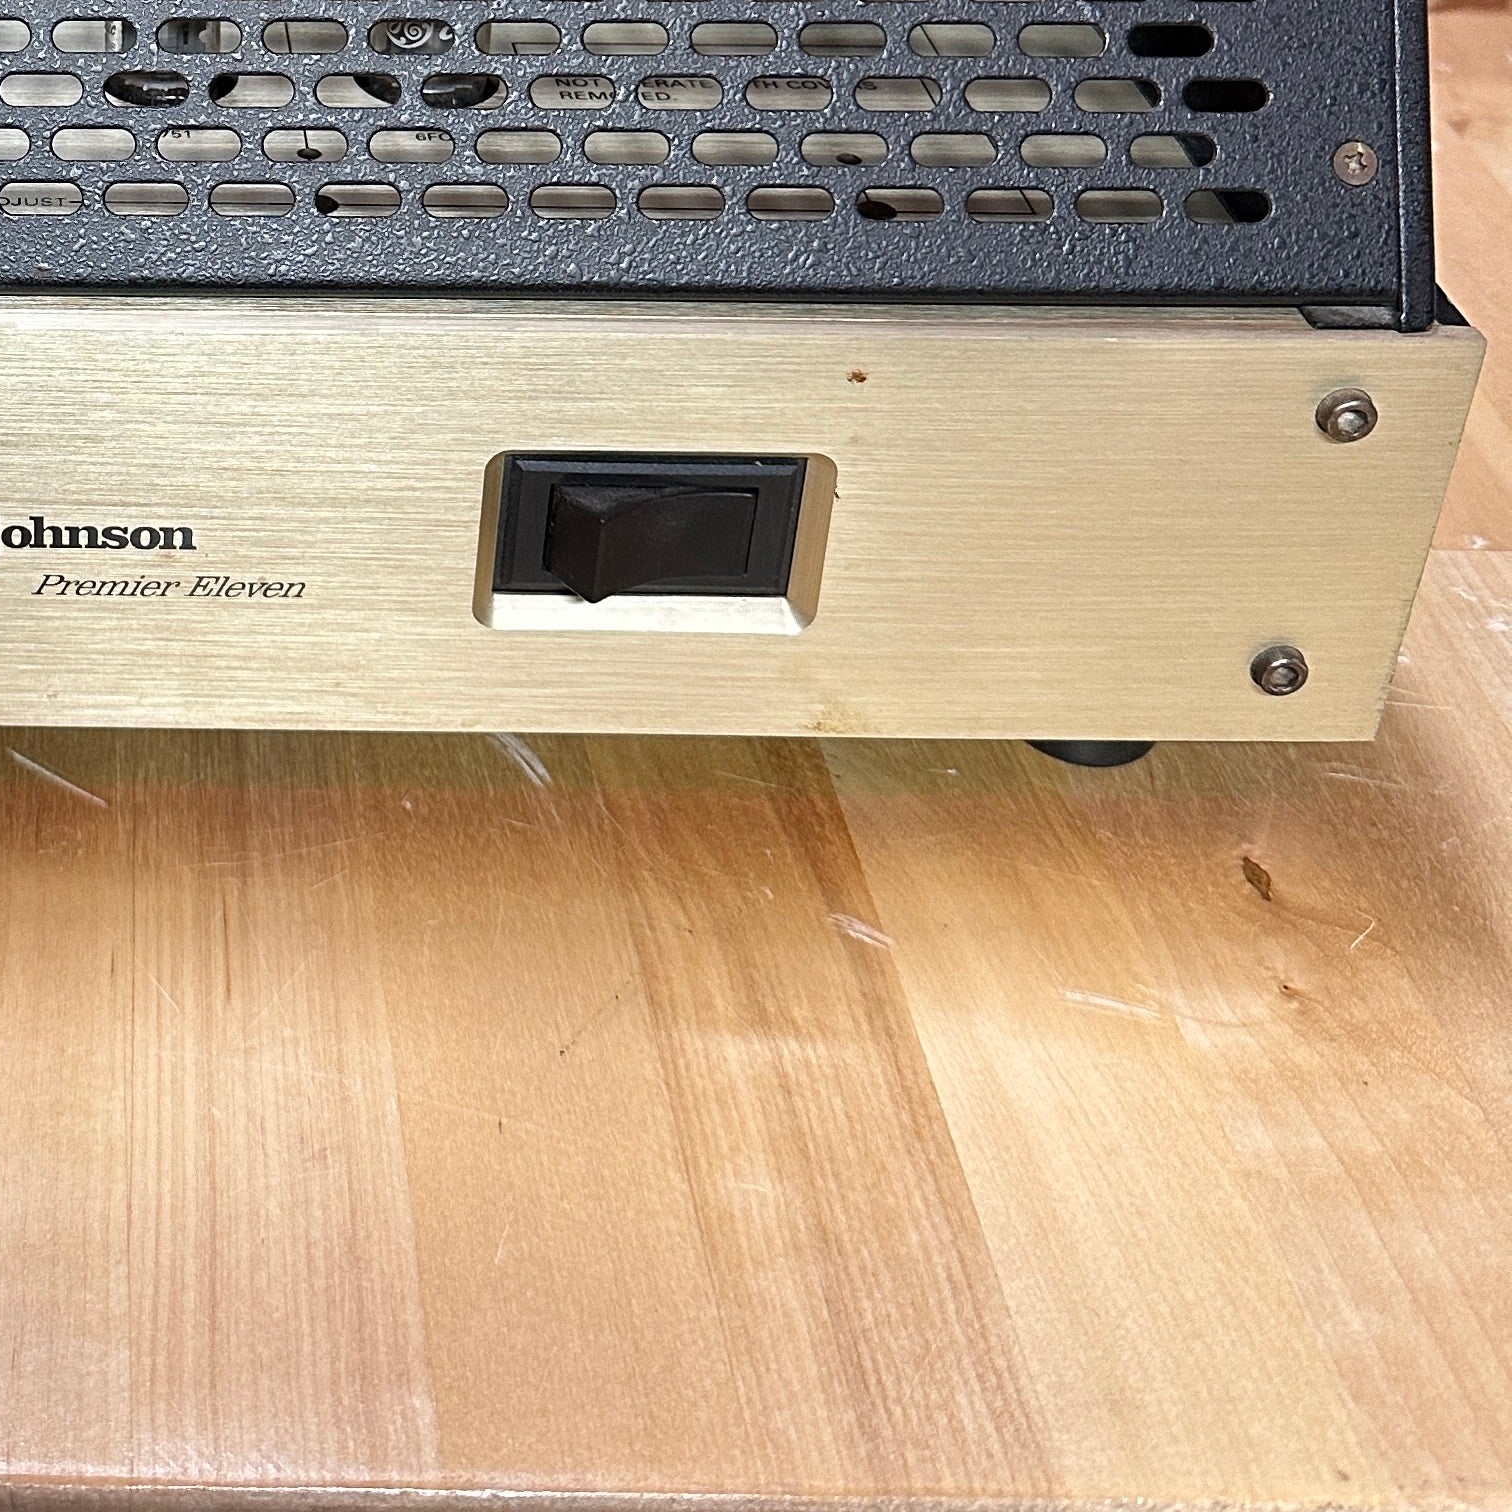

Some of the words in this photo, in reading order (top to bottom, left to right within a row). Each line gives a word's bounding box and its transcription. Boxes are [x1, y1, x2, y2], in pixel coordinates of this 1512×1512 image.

[555, 78, 600, 87] NOT
[0, 196, 68, 207] DJUST
[31, 573, 181, 599] Premier
[184, 575, 307, 600] Eleven
